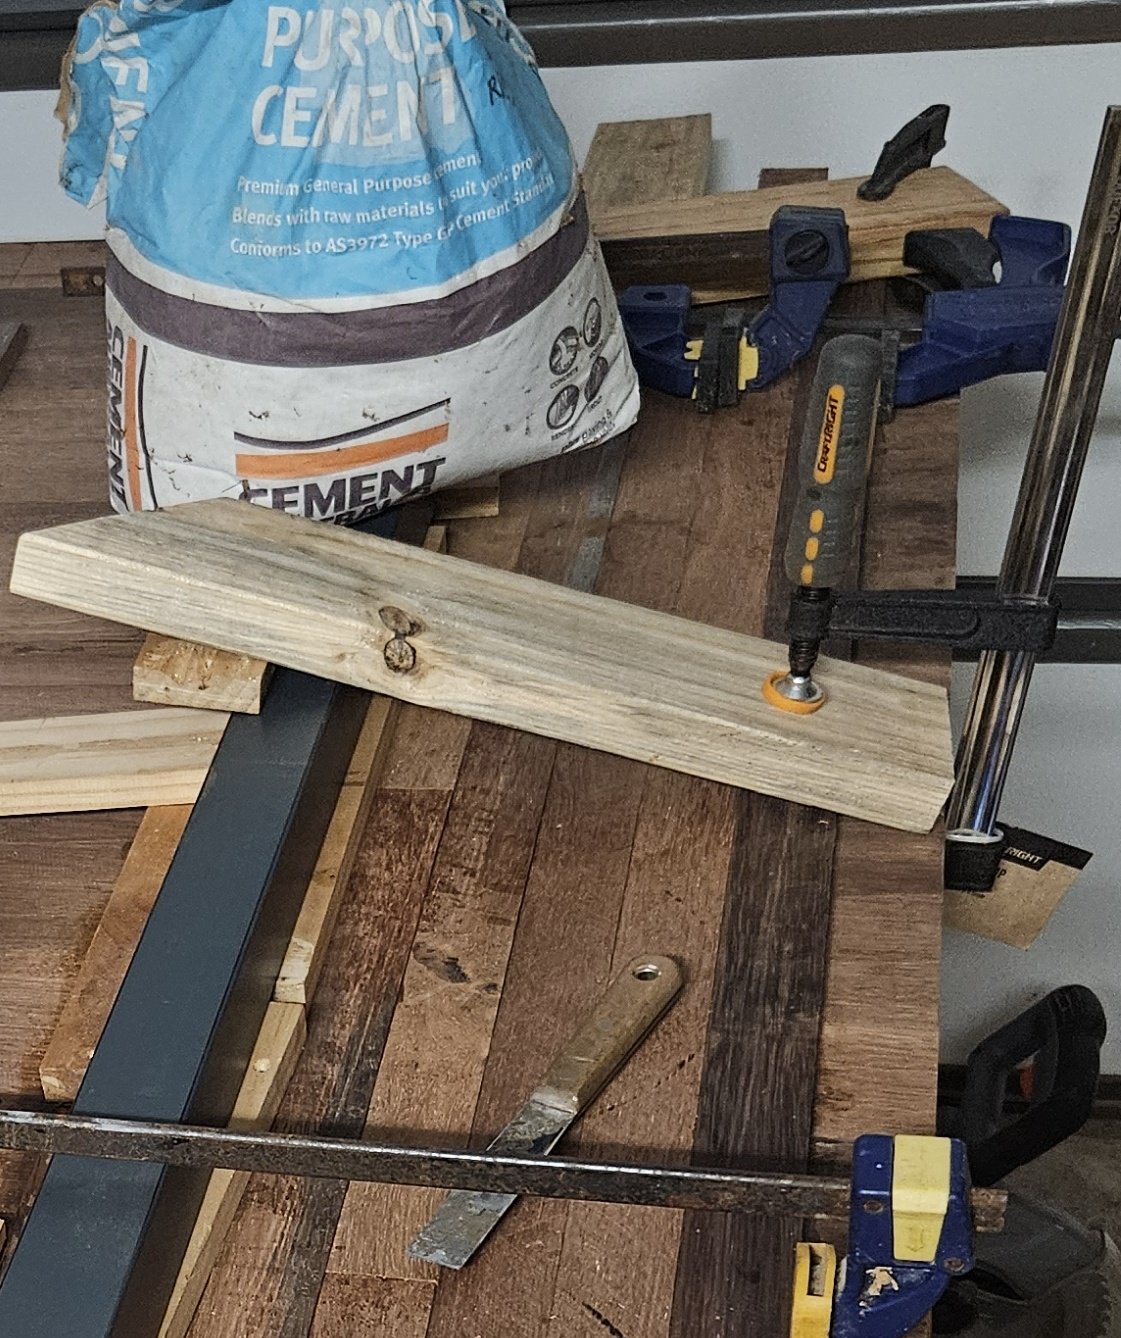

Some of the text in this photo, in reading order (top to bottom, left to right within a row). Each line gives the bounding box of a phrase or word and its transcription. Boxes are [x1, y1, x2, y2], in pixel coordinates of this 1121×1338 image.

[252, 67, 456, 147] CEMENT
[286, 206, 320, 226] with
[324, 210, 351, 224] raw
[356, 201, 435, 224] materials
[450, 181, 477, 202] suit
[303, 178, 358, 195] General
[364, 170, 431, 194] Purpose
[230, 238, 301, 257] Conforms
[305, 240, 321, 254] to
[326, 233, 389, 253] AS3972
[393, 230, 432, 249] Type
[456, 200, 510, 230] Cement
[109, 325, 129, 509] CEMENT
[817, 394, 839, 473] CRAFTRIGHT
[1004, 846, 1044, 864] RIGHT
